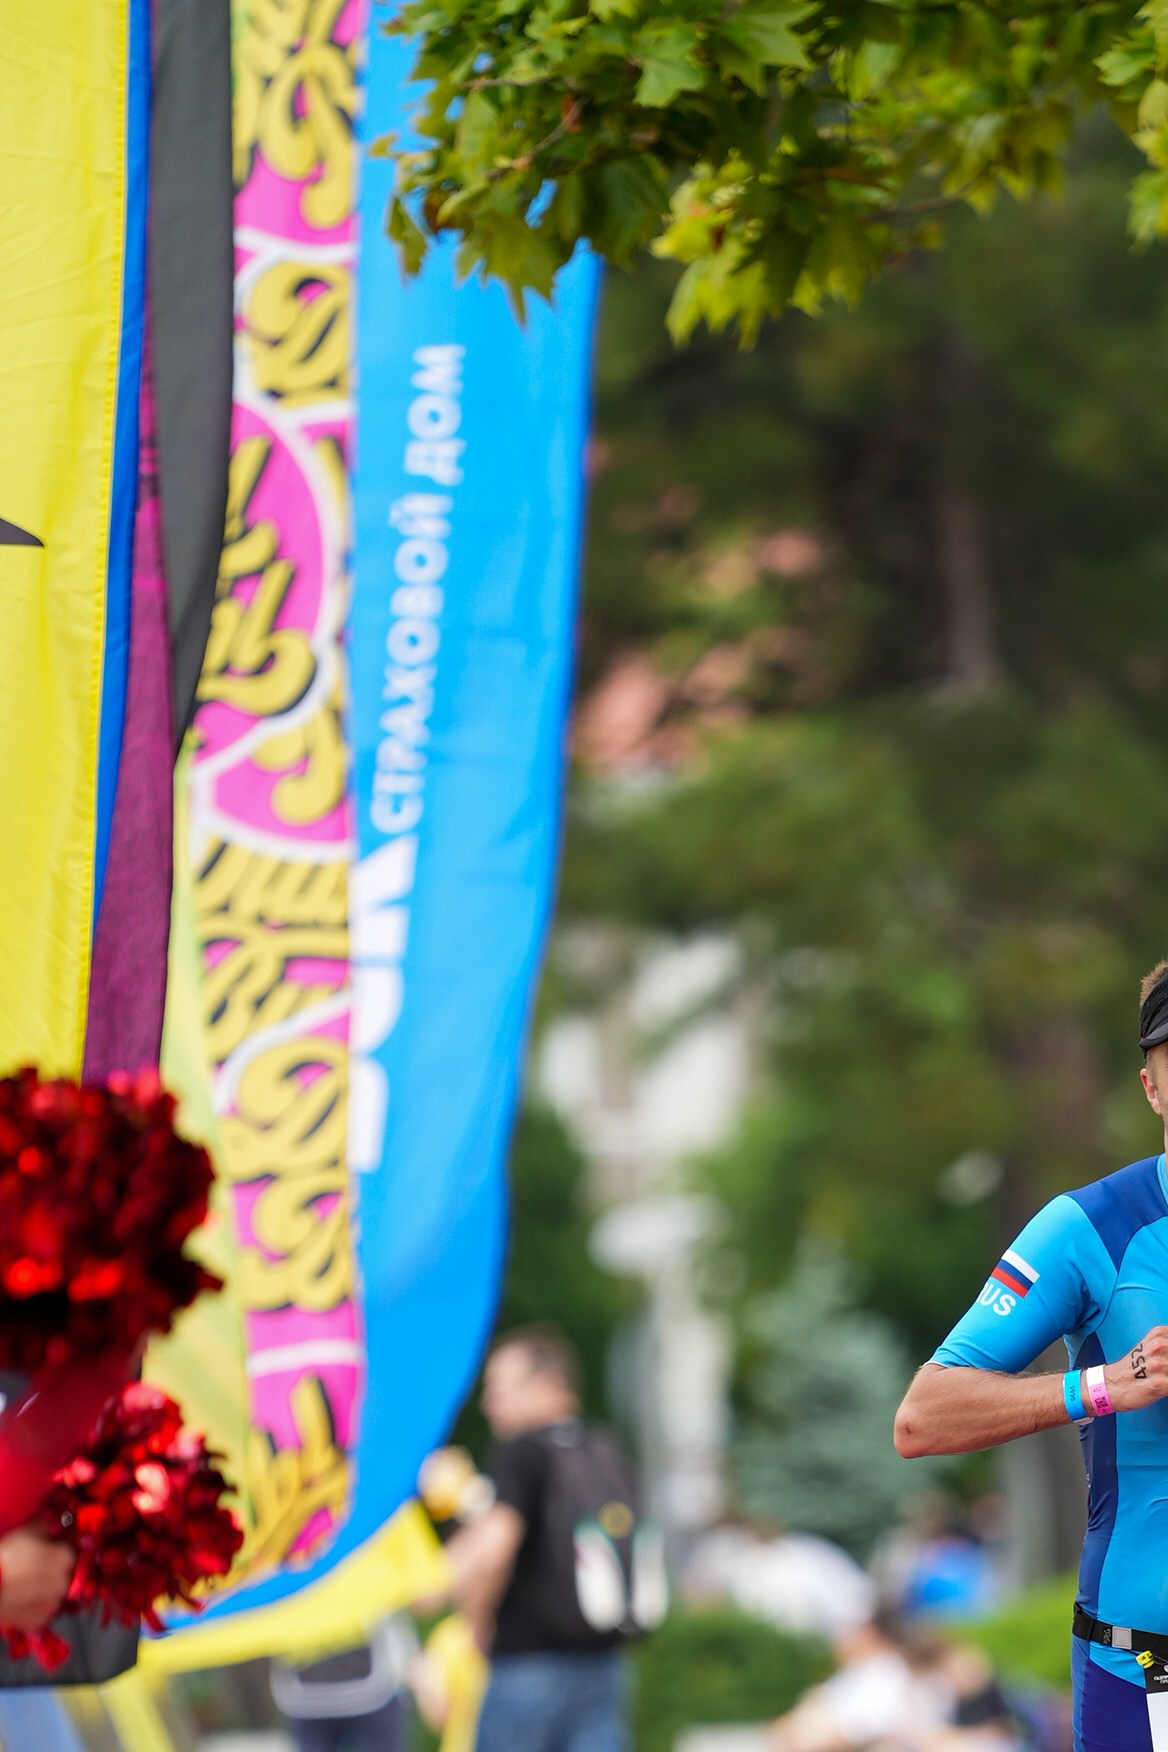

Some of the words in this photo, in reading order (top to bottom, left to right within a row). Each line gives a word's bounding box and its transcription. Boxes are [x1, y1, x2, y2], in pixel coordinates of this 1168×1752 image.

[404, 343, 467, 486] ДОМ
[370, 493, 453, 834] СТРАХОВОЙ
[1131, 1343, 1147, 1380] 452
